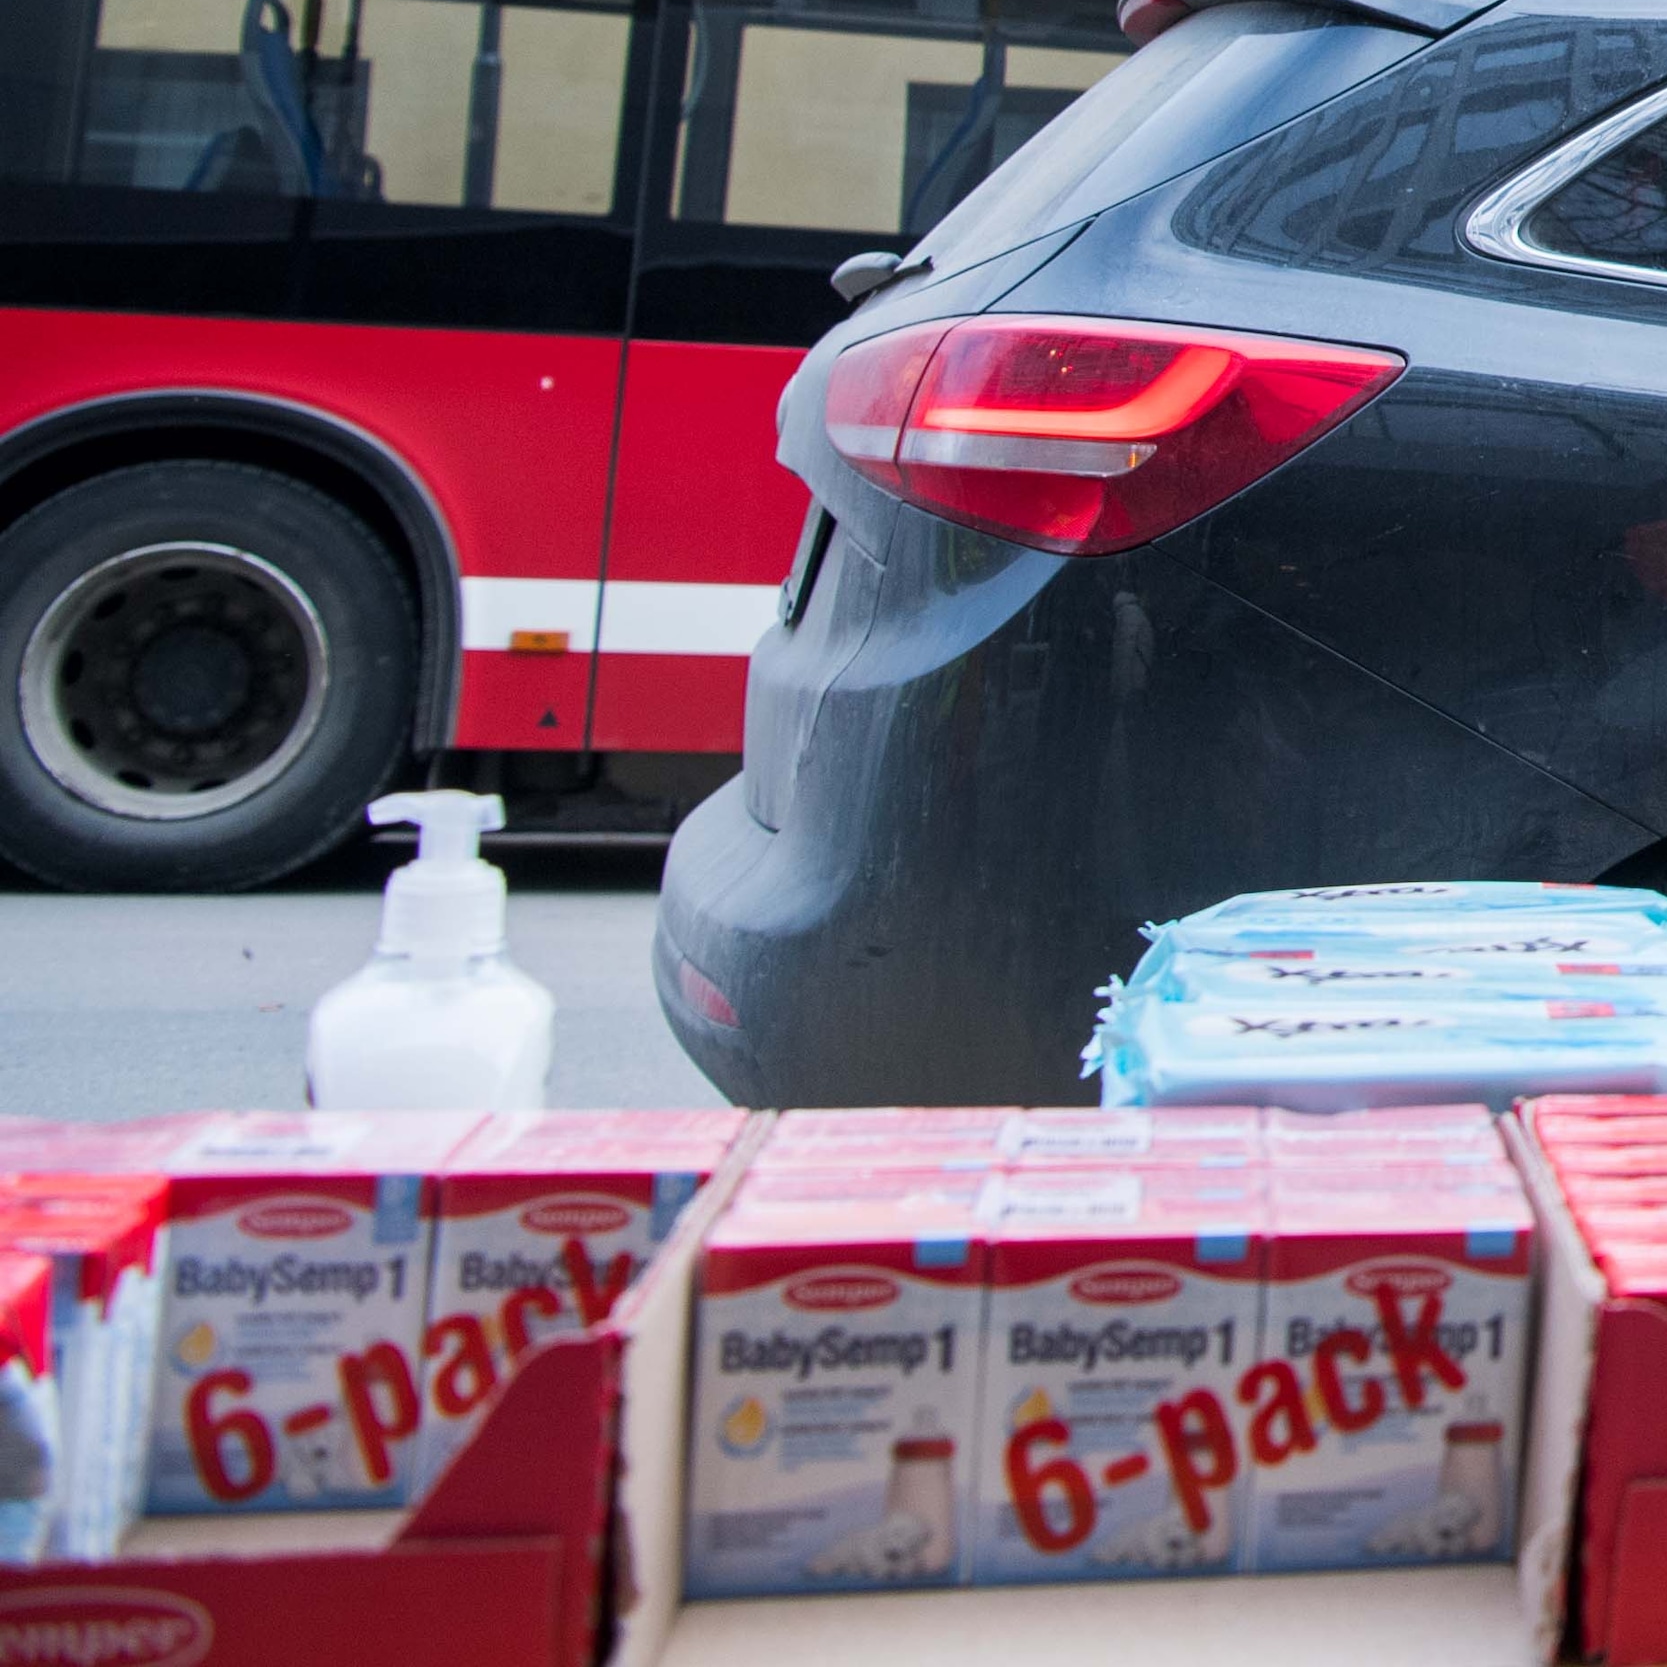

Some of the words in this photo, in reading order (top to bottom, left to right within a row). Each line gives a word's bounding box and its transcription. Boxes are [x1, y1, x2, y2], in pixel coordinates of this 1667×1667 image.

[176, 1254, 380, 1305] BabySemp
[720, 1326, 928, 1381] BabySemp
[1008, 1318, 1208, 1372] BabySemp
[1005, 1279, 1468, 1556] 6-pack
